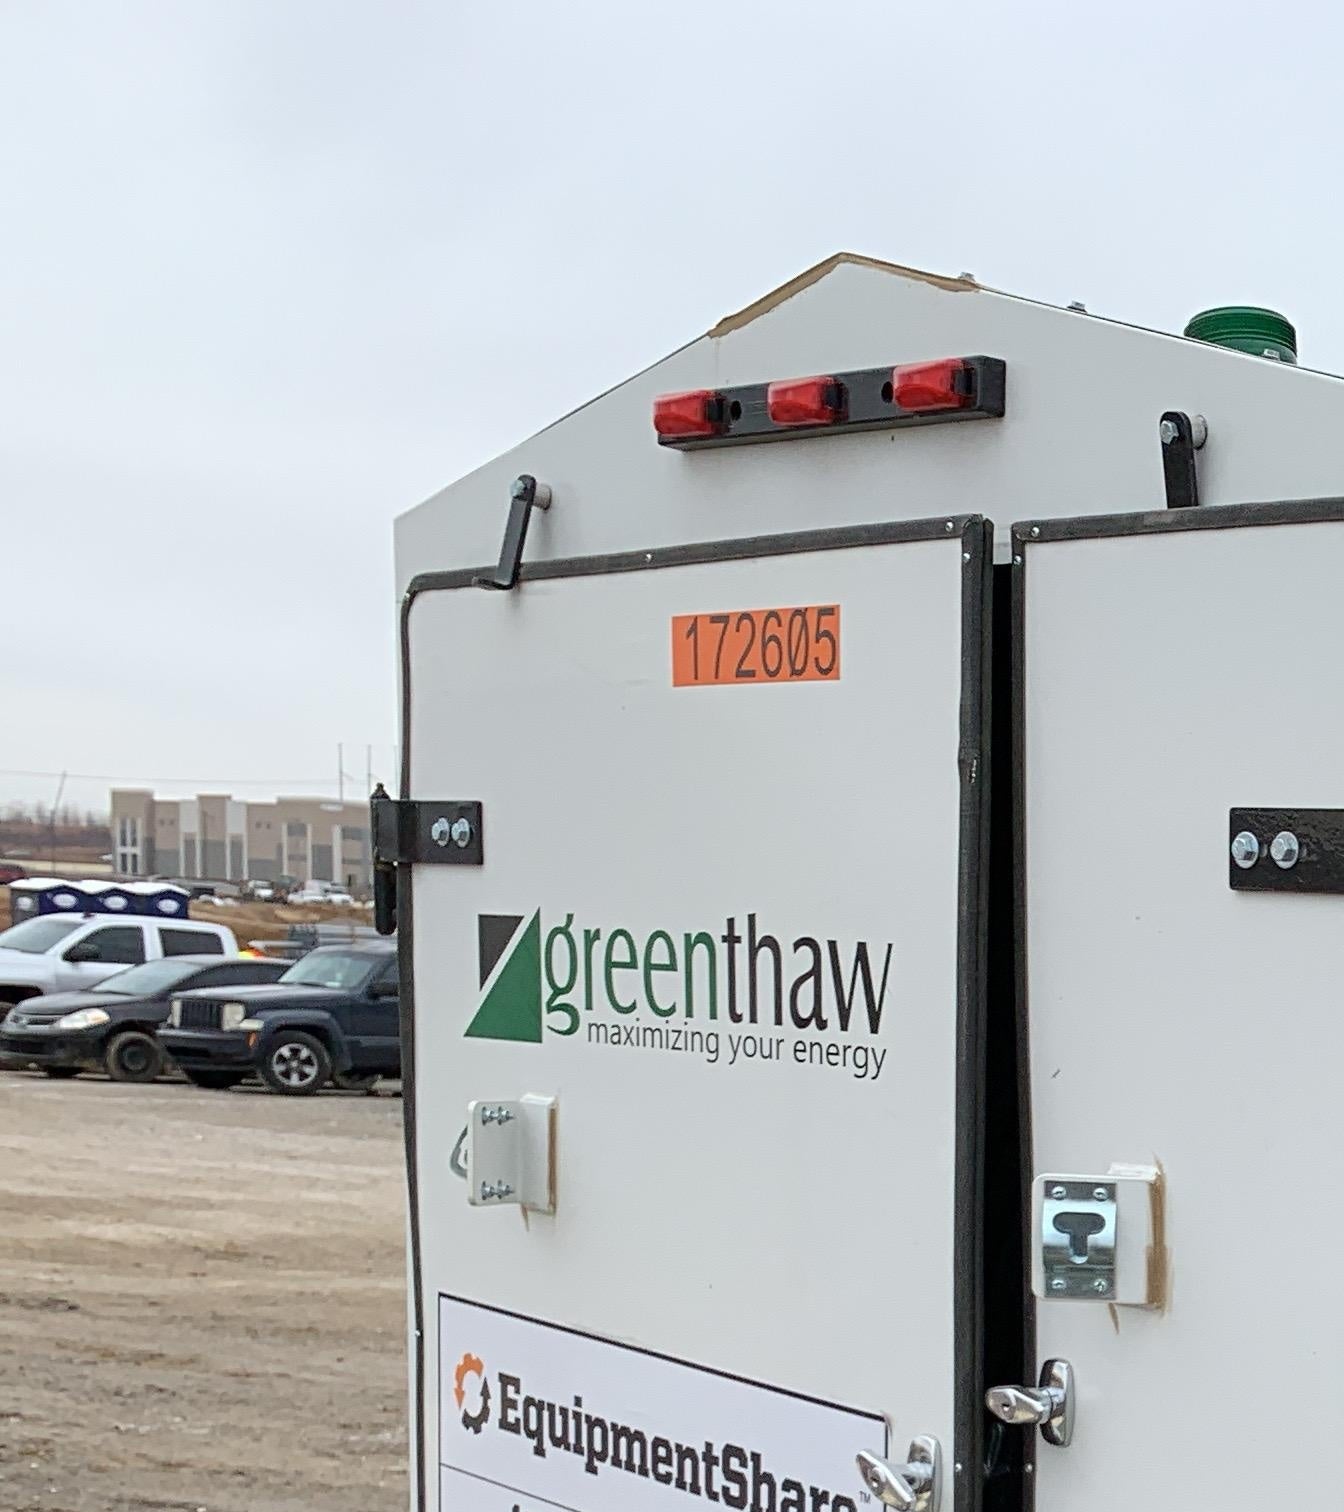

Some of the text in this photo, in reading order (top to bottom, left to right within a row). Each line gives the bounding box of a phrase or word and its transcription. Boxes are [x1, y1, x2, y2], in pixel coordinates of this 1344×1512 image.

[686, 607, 837, 681] 172605
[545, 912, 894, 1037] greenthaw
[588, 1018, 887, 1080] maximizing your energy
